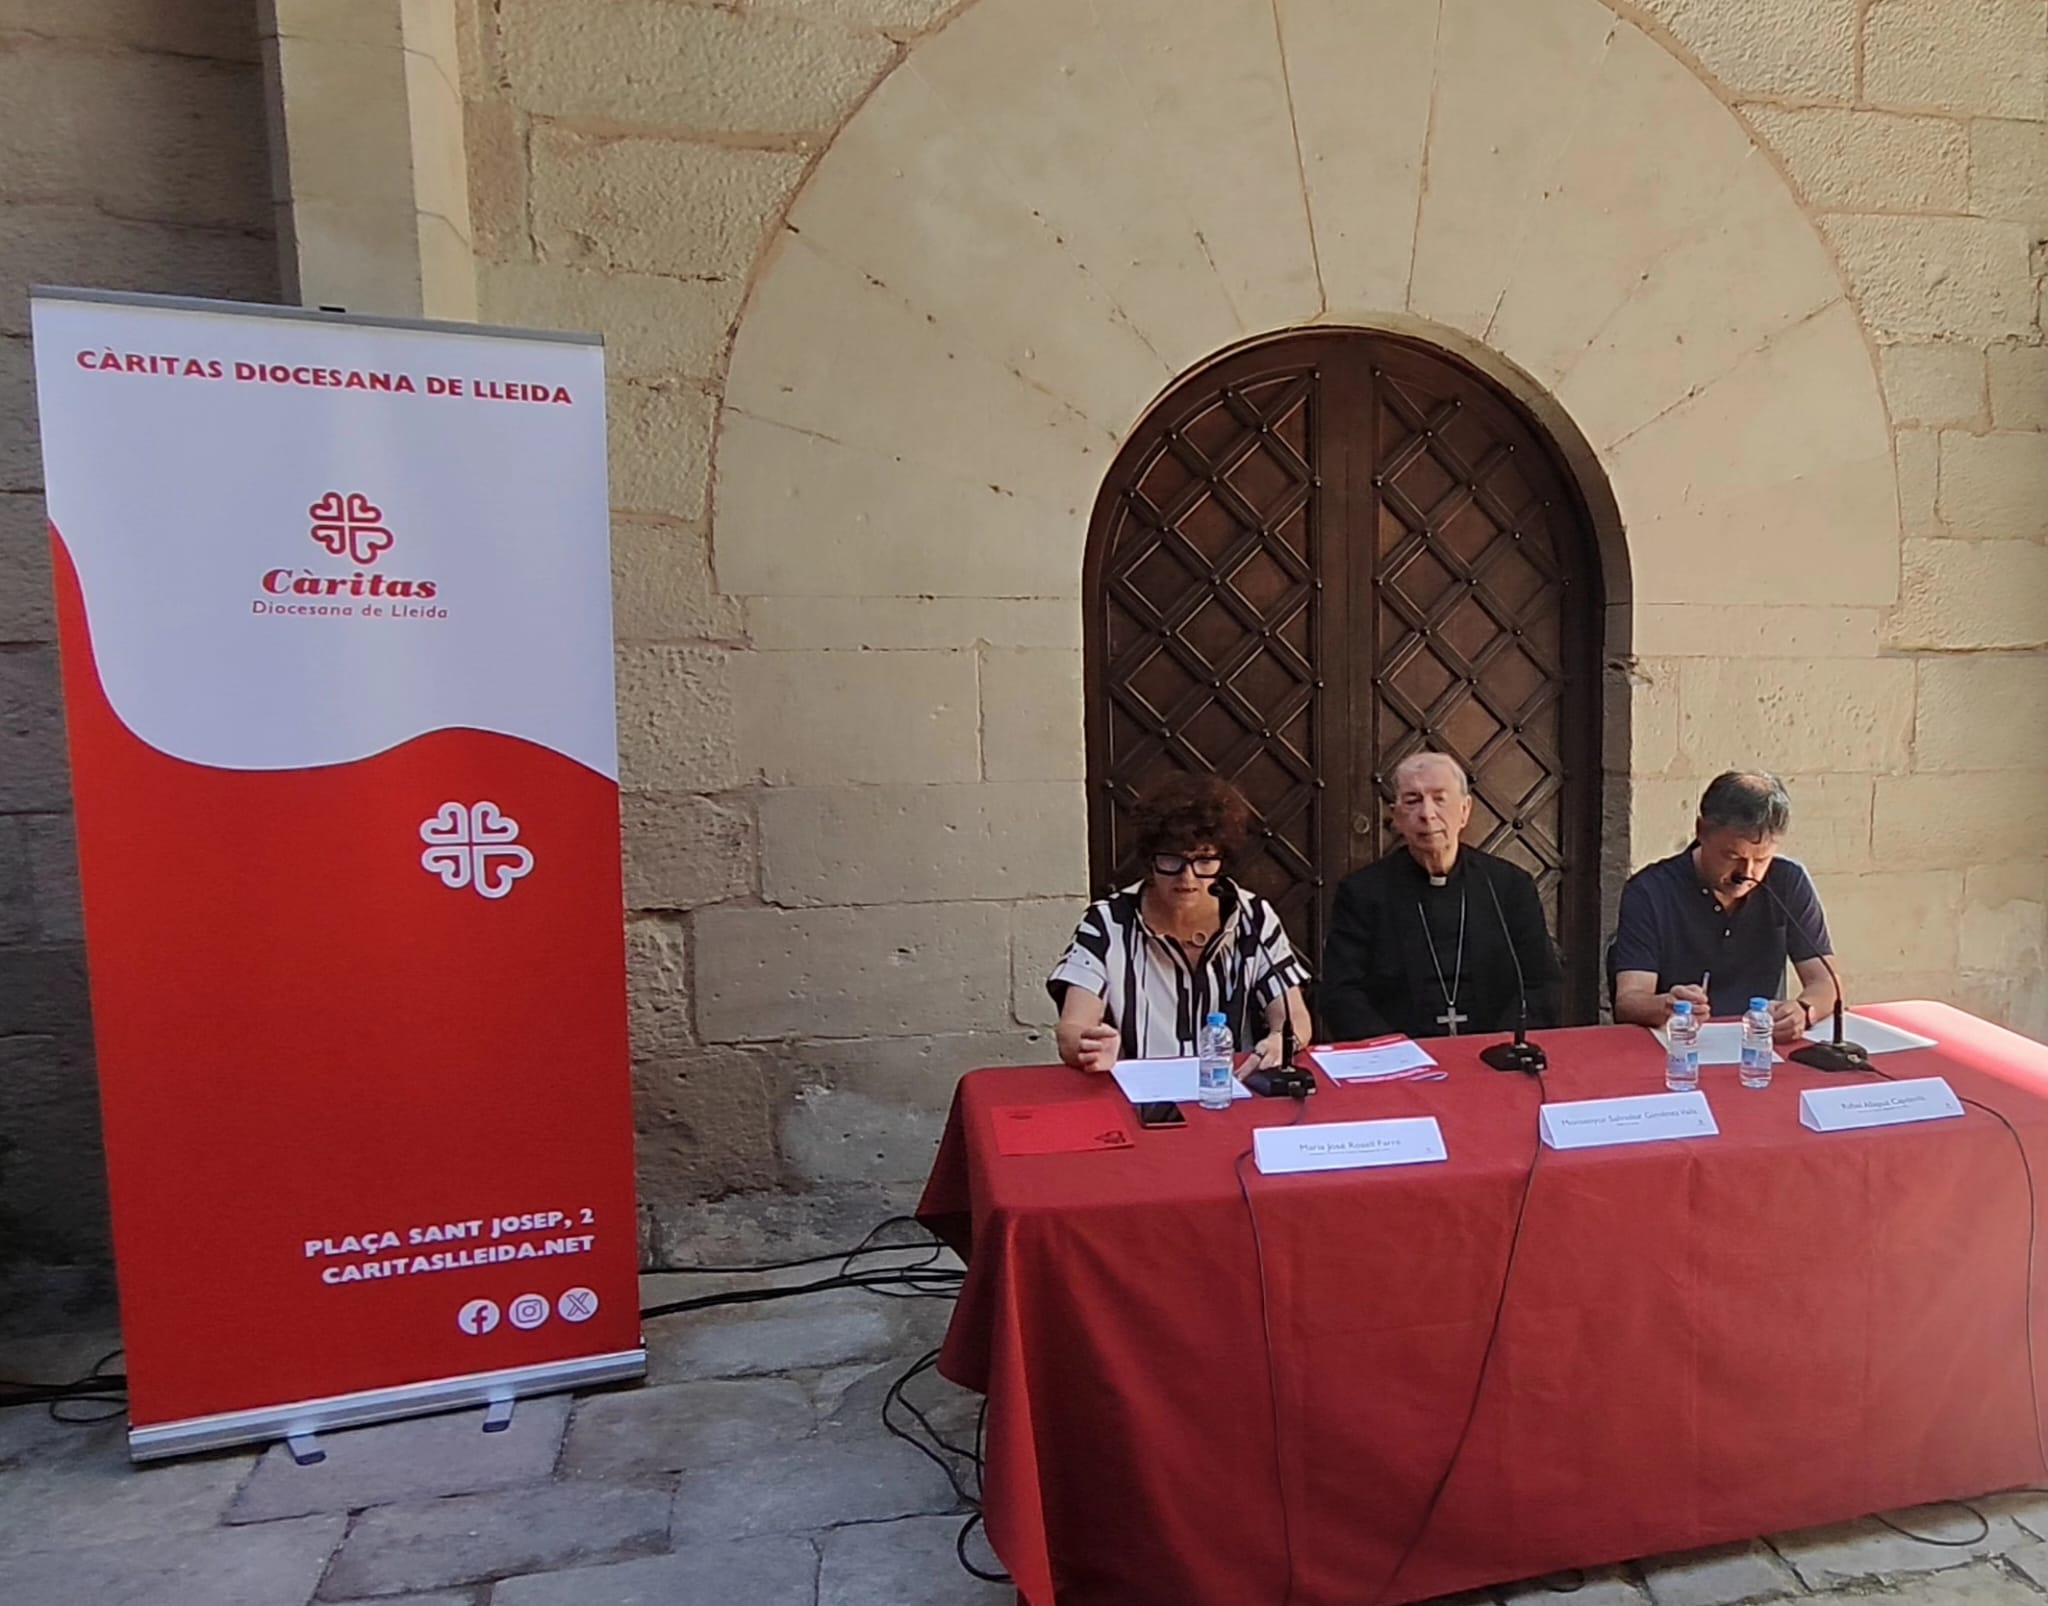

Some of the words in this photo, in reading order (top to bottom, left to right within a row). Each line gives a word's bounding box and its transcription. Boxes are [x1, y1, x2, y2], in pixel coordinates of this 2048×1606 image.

[77, 347, 223, 379] CÀRITAS
[234, 361, 416, 393] DIOCESANA
[426, 375, 464, 397] DE
[473, 379, 573, 404] LLEIDA
[262, 568, 437, 598] Càritas
[252, 600, 353, 617] Diocesana
[361, 603, 383, 617] de
[391, 604, 448, 619] Lleida
[304, 1231, 401, 1257] PLAÇA
[408, 1220, 484, 1245] SANT
[490, 1210, 573, 1239] JOSEP,
[579, 1207, 595, 1224] 2
[321, 1234, 596, 1285] CARITASLLEIDA.NET
